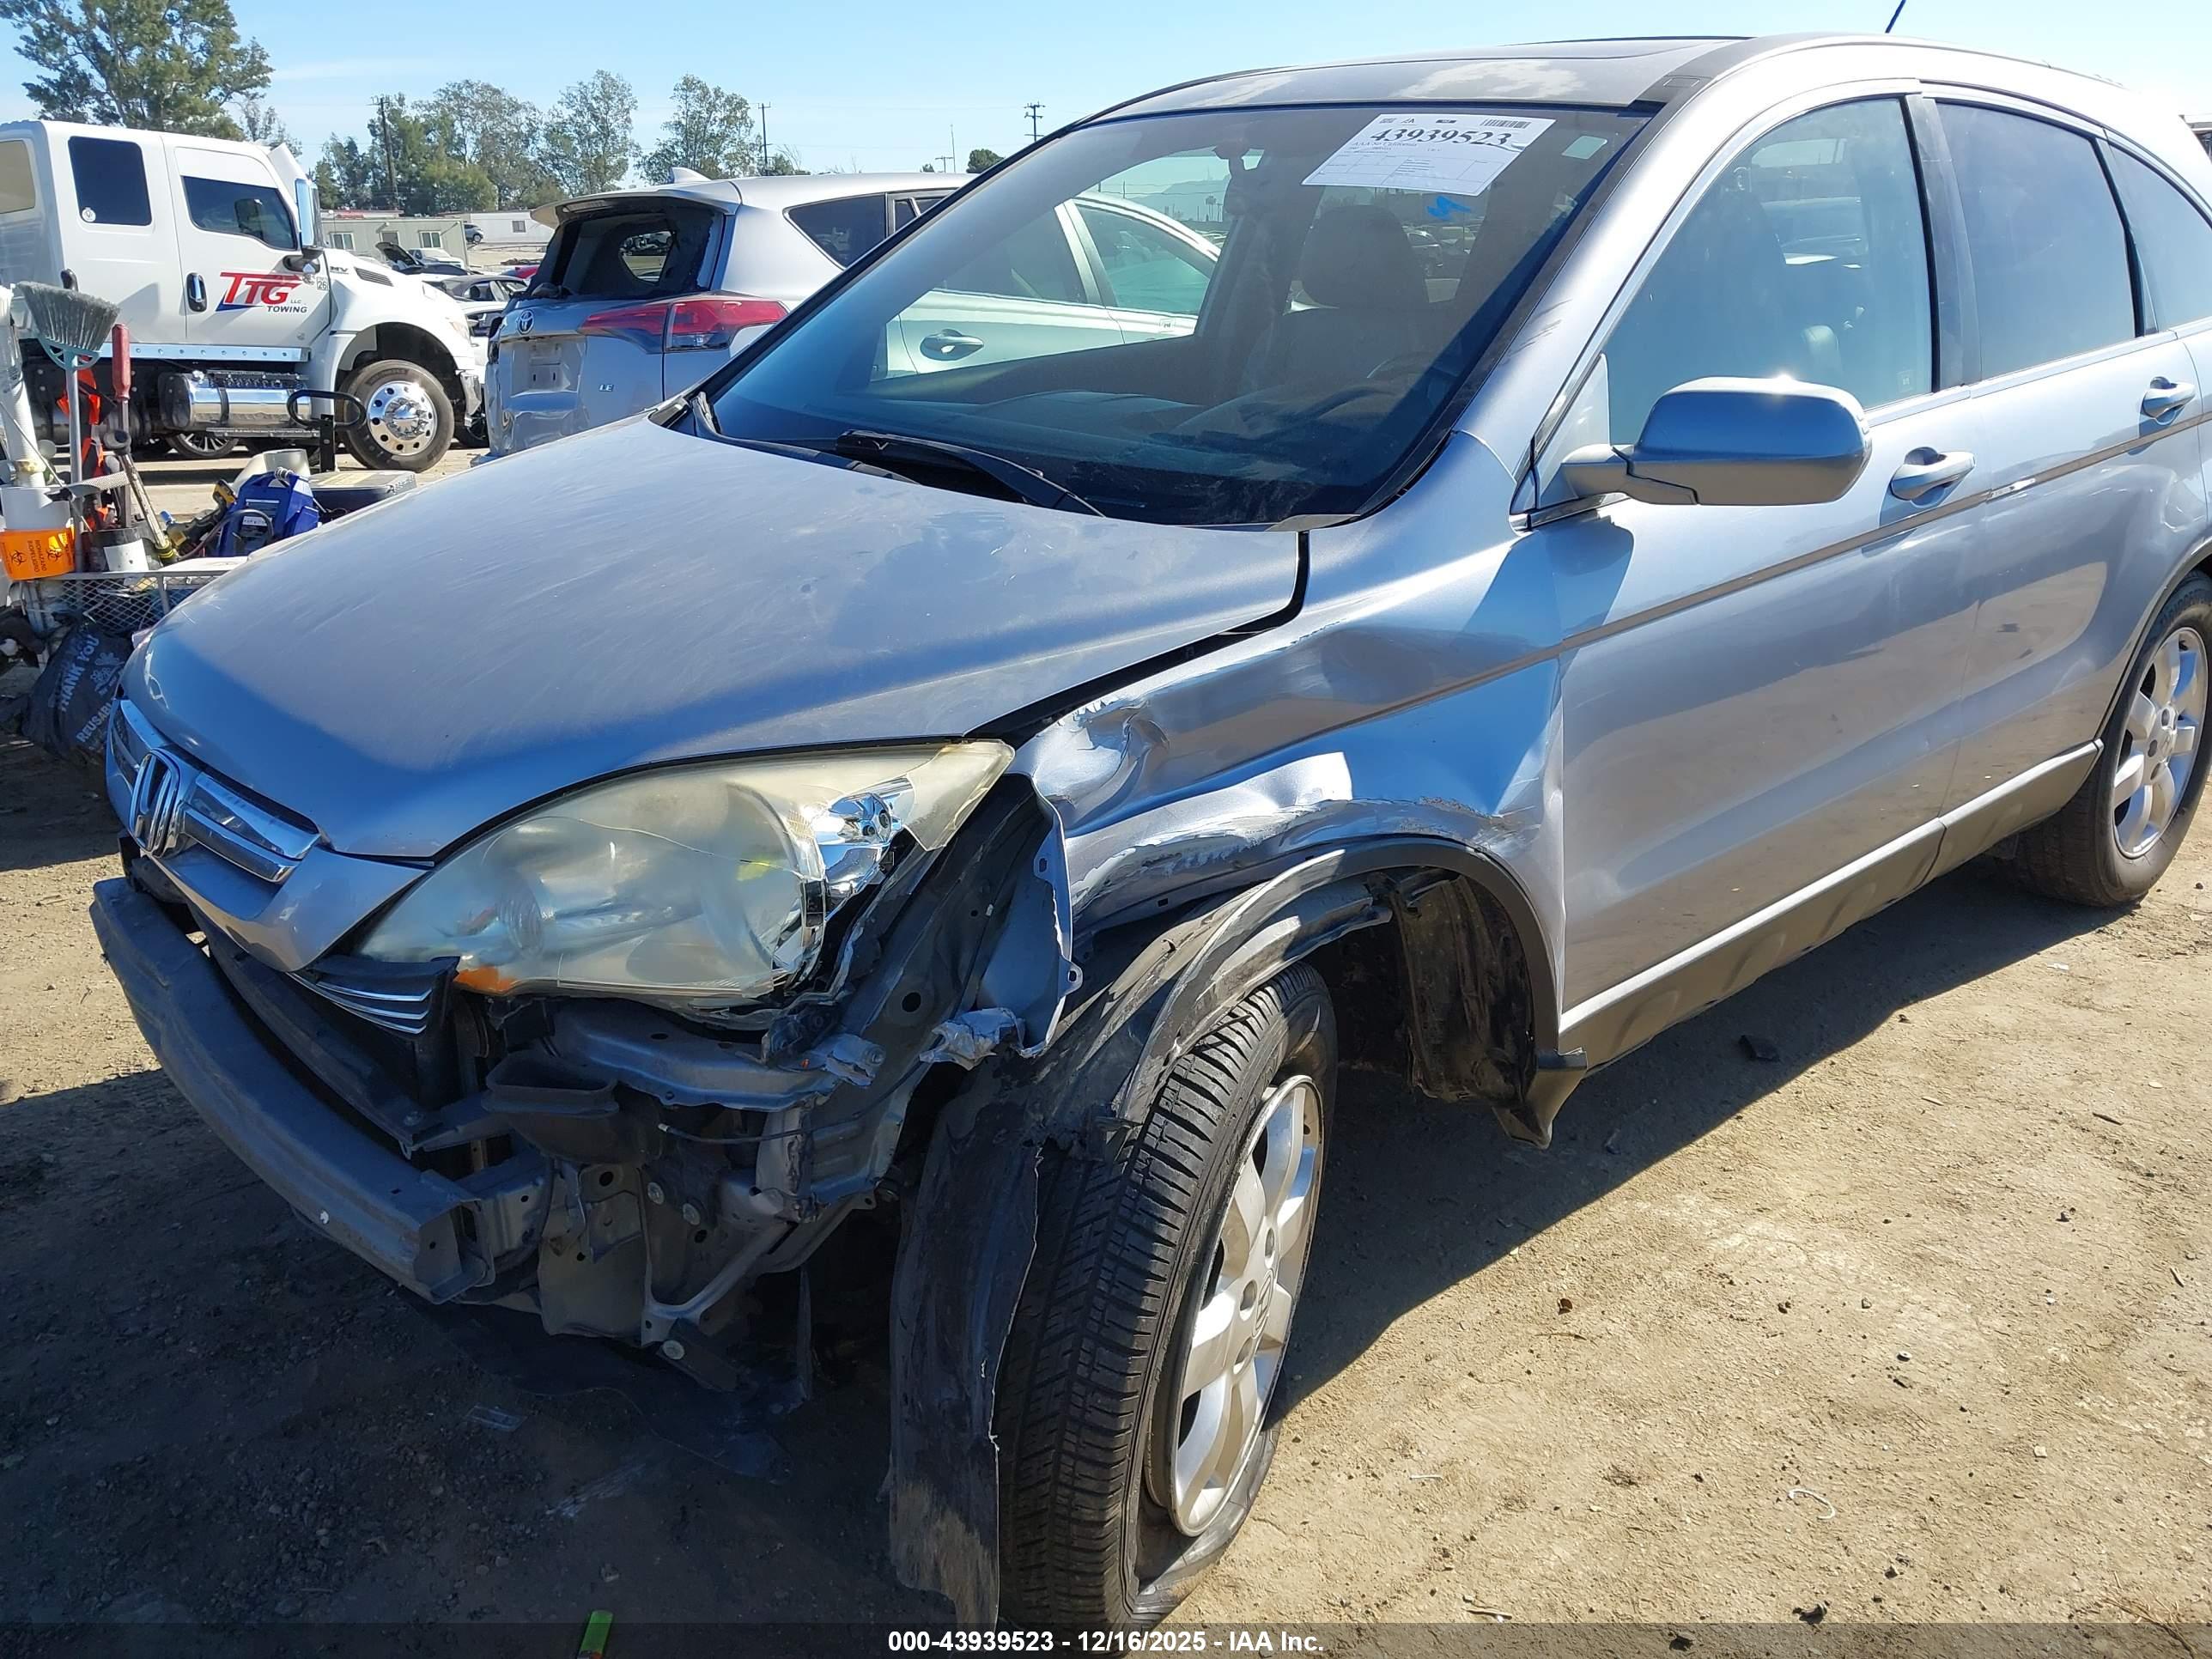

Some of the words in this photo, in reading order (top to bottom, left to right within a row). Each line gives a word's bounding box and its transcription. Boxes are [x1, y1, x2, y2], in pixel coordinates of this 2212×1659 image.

[1370, 128, 1512, 145] 43939523
[220, 271, 302, 305] TTG
[267, 305, 307, 313] TOWING
[77, 634, 100, 662] YOU
